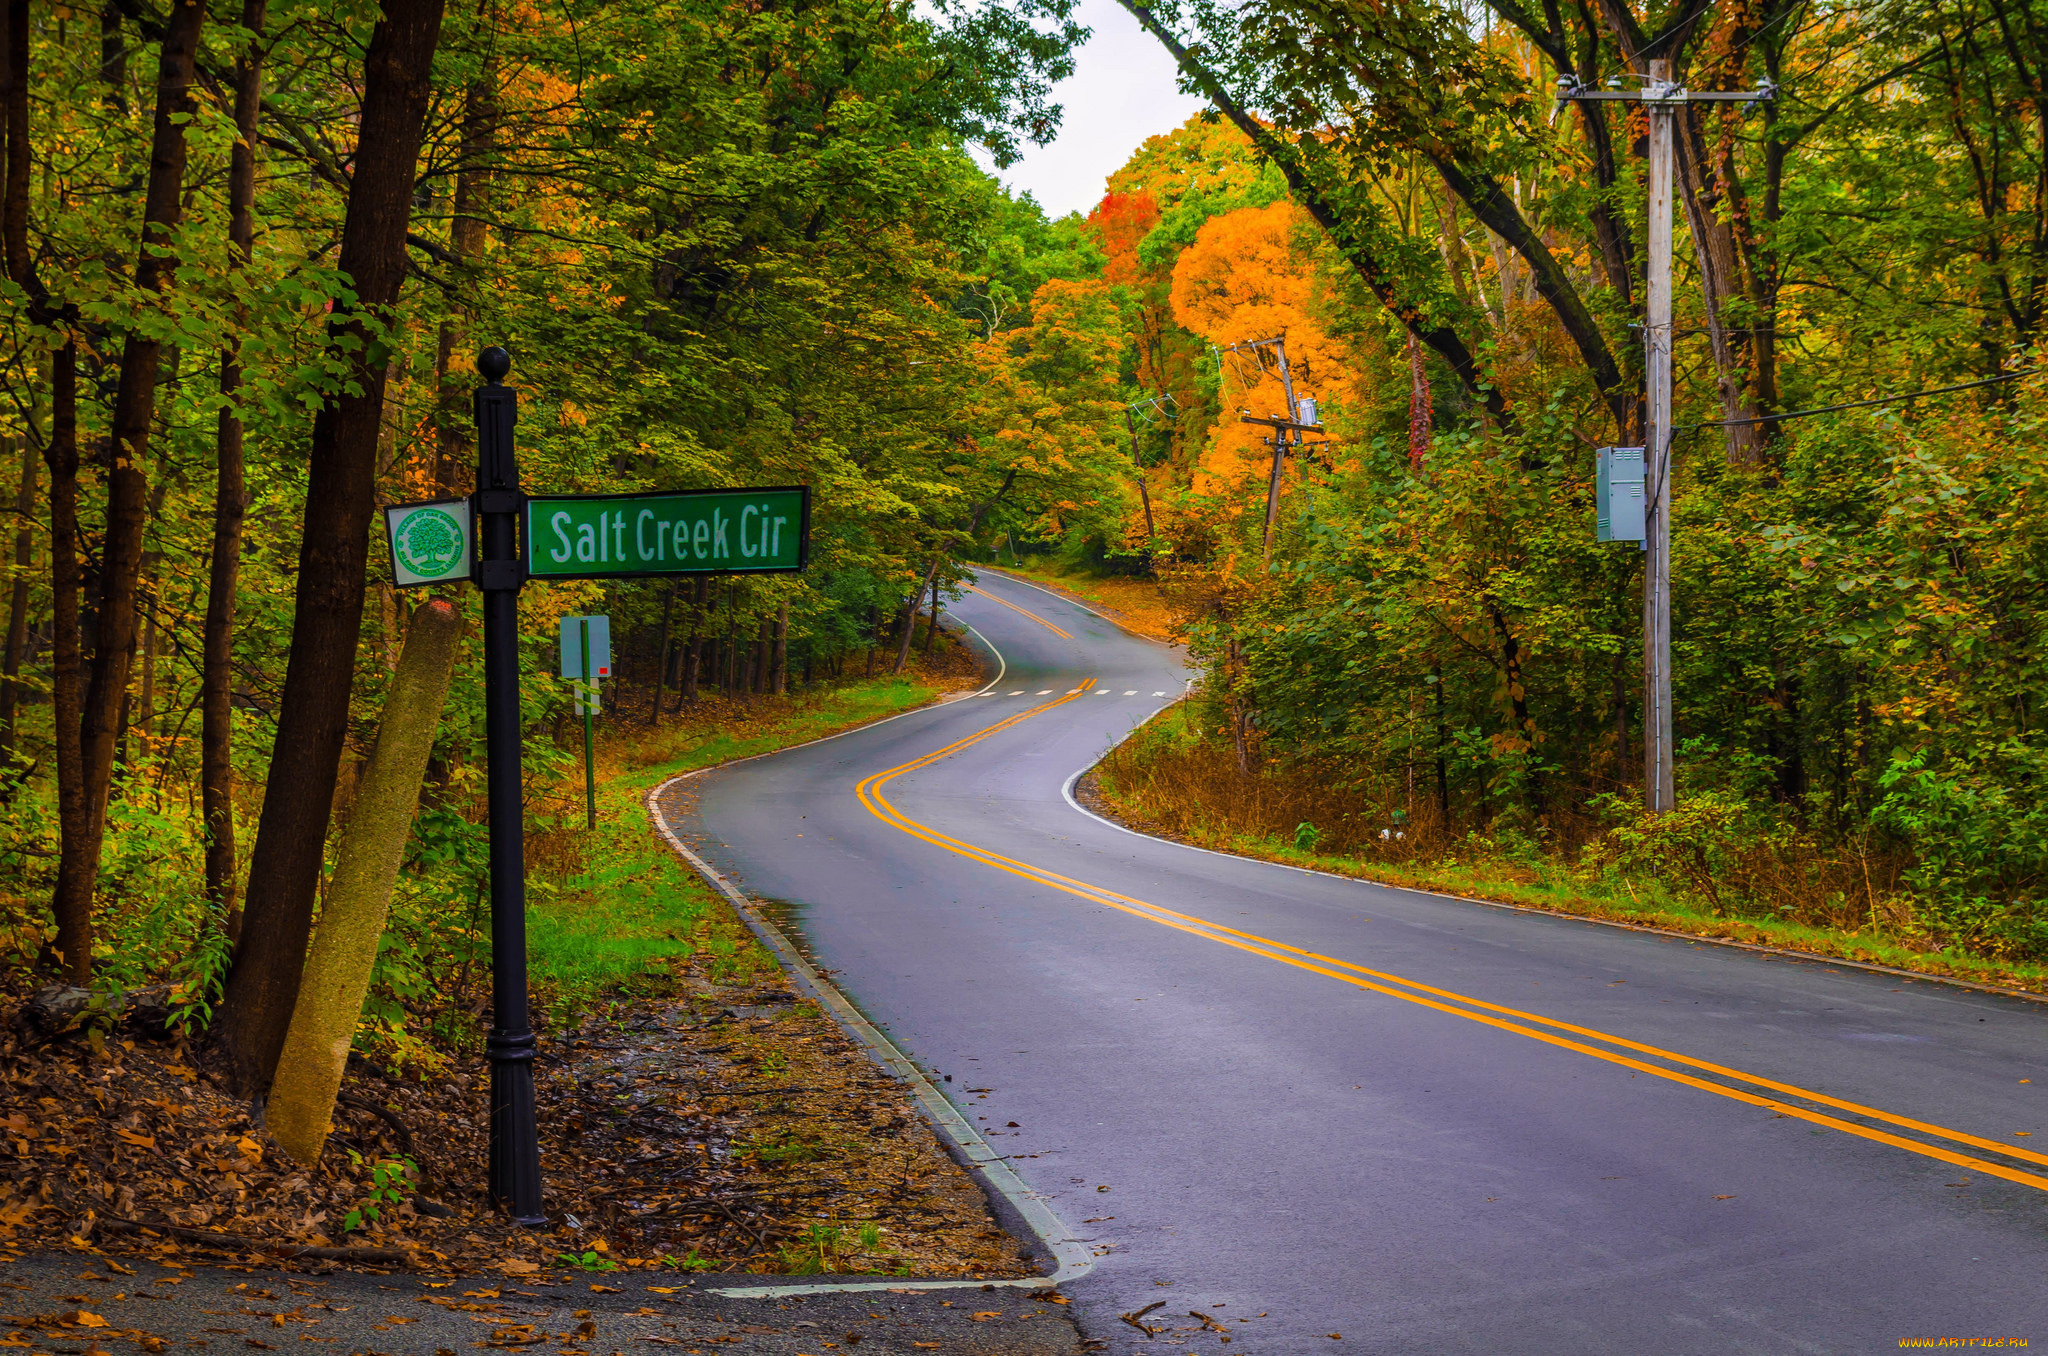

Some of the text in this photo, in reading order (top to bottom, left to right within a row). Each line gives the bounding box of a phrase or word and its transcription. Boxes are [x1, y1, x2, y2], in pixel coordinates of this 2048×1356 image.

[399, 515, 417, 536] VILLAGE
[440, 513, 456, 531] BROOK
[550, 504, 787, 563] Salt Creek Cir
[406, 559, 419, 570] PAGE
[445, 545, 460, 569] ILLINOIS
